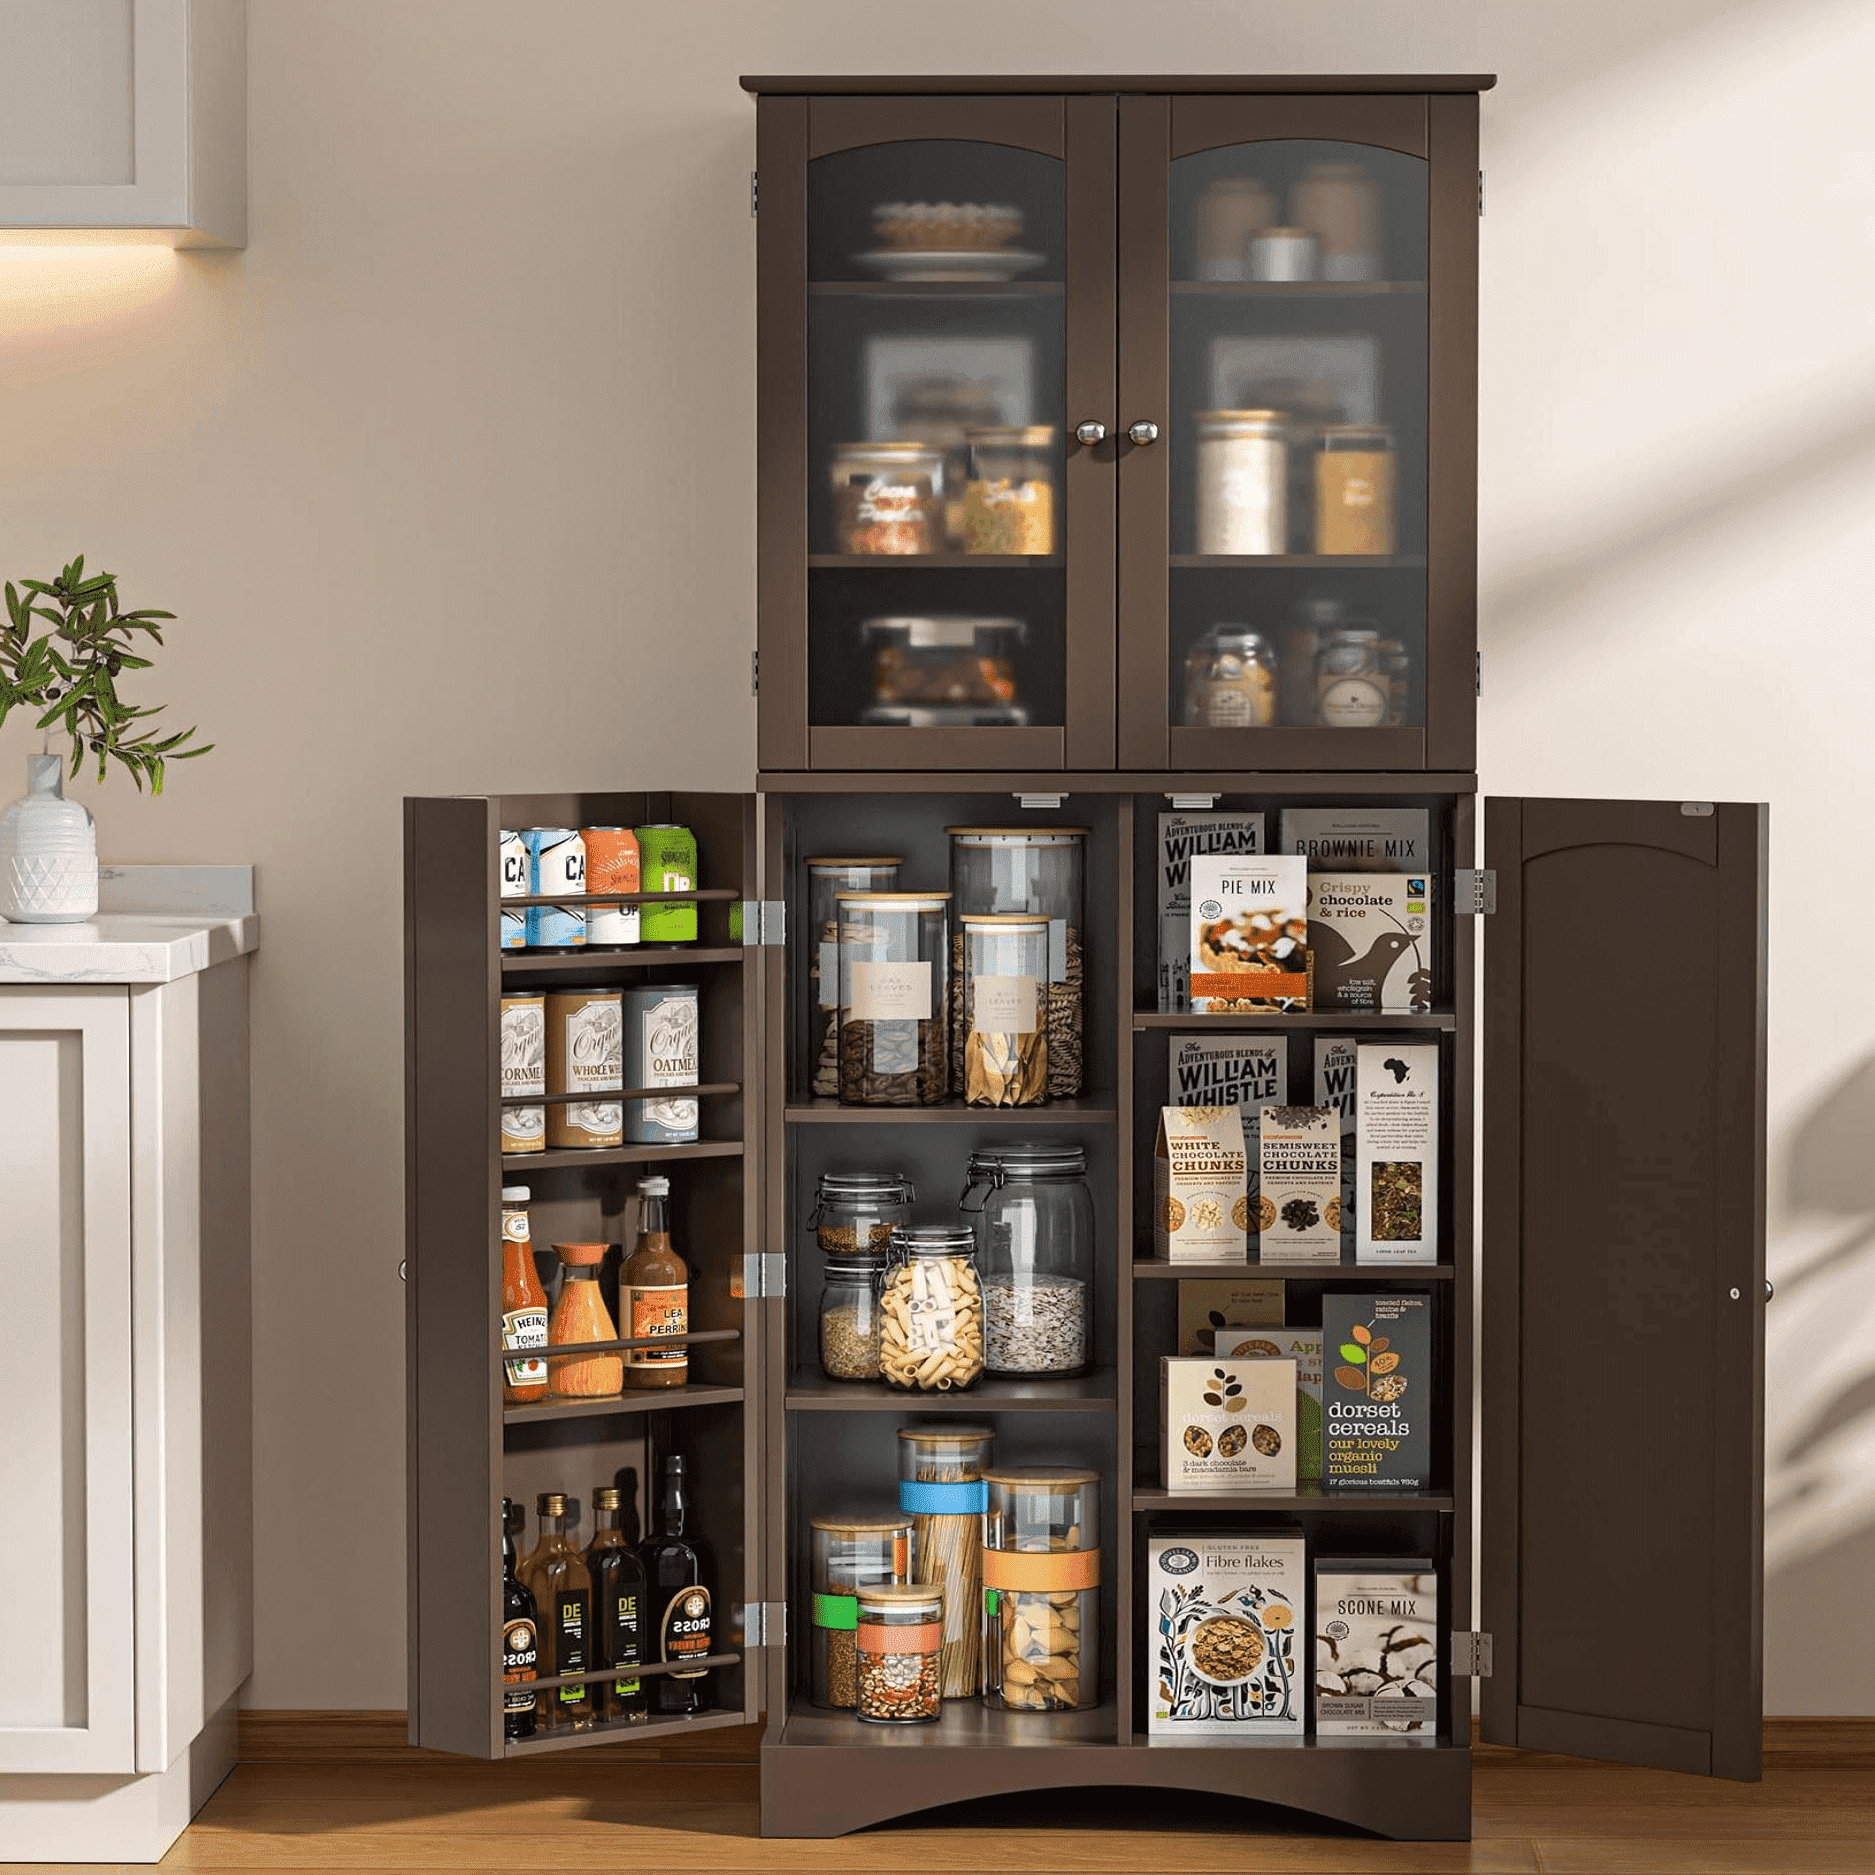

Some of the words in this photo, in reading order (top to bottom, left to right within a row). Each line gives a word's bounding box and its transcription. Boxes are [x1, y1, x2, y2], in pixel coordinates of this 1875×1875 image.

[1165, 830, 1256, 864] WILLIAM
[1296, 840, 1374, 857] BROWNIE
[1385, 840, 1416, 857] MIX
[1222, 880, 1243, 894] PIE
[1251, 880, 1276, 894] MIX
[1320, 882, 1371, 896] Crispy
[1319, 894, 1393, 906] chocolate
[1319, 908, 1333, 918] &
[1337, 908, 1366, 918] rice
[1178, 1050, 1234, 1065] ADVENTUROUS
[1236, 1049, 1263, 1058] BLENDS
[572, 1064, 606, 1076] WHOLE
[1178, 1058, 1276, 1093] WILLIAM
[1171, 1142, 1220, 1150] WHITE
[1263, 1142, 1338, 1150] SEMISWEET
[1171, 1151, 1244, 1160] CHOCOLATE
[1172, 1160, 1244, 1171] CHUNKS
[1263, 1160, 1338, 1170] CHUNKS
[664, 1308, 683, 1318] LEA
[517, 1316, 546, 1329] HEINZ
[1329, 1402, 1401, 1418] dorset
[1329, 1420, 1410, 1436] cereals
[1329, 1440, 1354, 1450] our
[1356, 1438, 1401, 1451] lovely
[1329, 1451, 1383, 1464] organic
[1329, 1462, 1378, 1474] muesli
[1206, 1555, 1241, 1568] Fibre
[1245, 1555, 1284, 1568] flakes
[1338, 1600, 1384, 1615] SCONE
[1391, 1600, 1416, 1615] MIX
